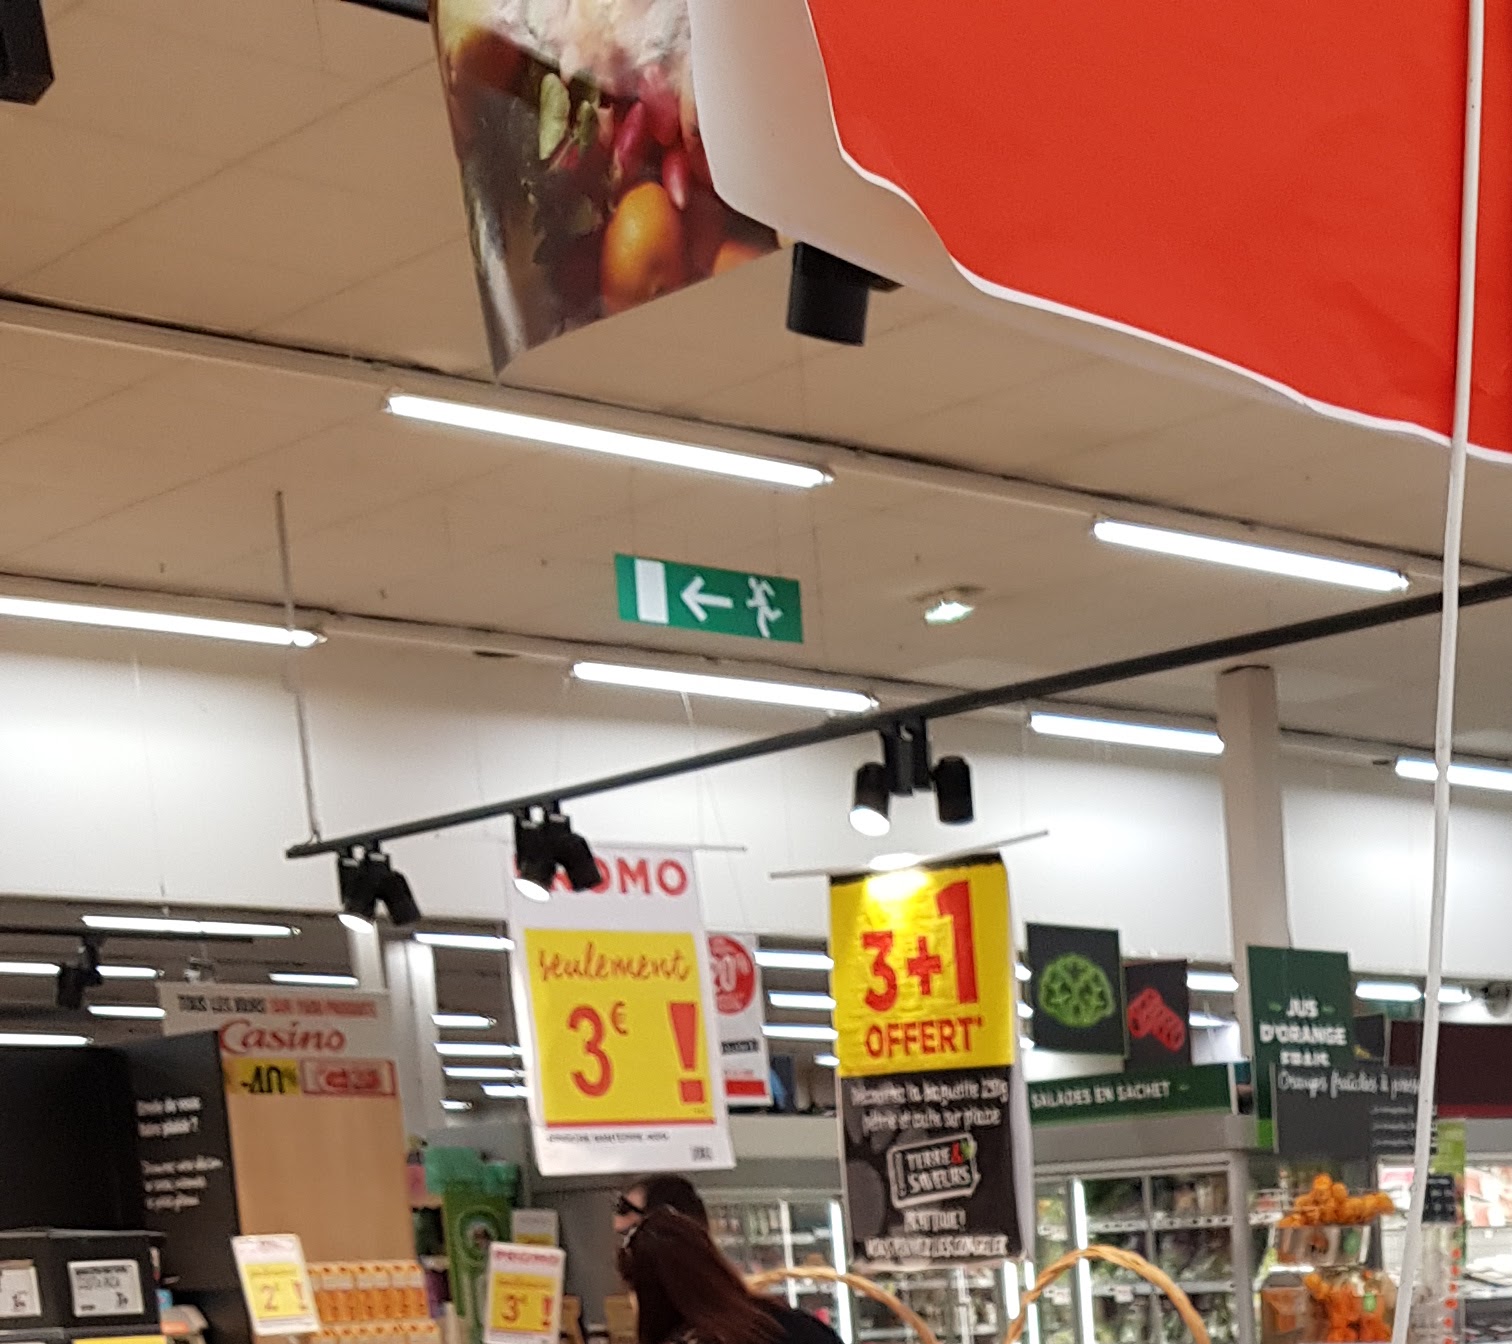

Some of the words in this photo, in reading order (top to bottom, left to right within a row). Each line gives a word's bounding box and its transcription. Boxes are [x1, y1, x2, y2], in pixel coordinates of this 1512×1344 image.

[540, 943, 690, 982] seulement
[861, 880, 980, 1014] 3+1
[220, 1018, 346, 1054] Casino
